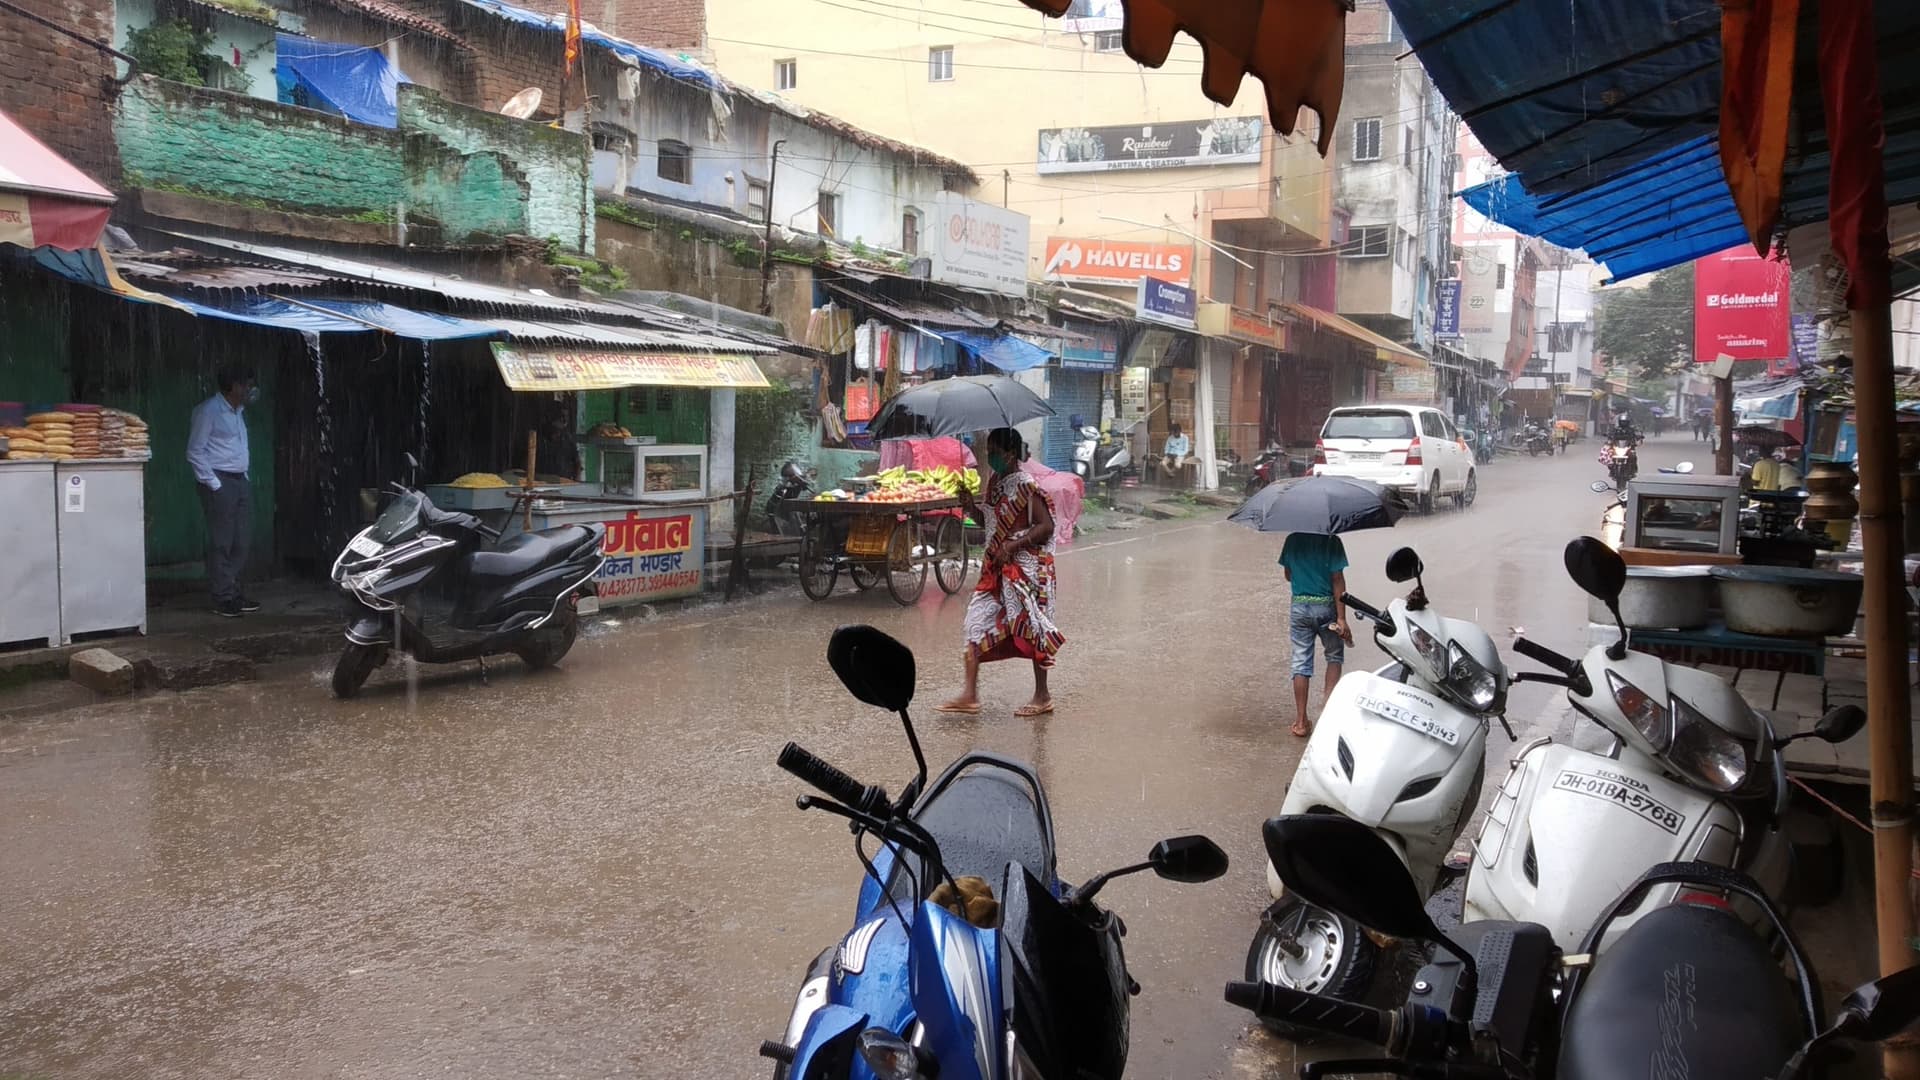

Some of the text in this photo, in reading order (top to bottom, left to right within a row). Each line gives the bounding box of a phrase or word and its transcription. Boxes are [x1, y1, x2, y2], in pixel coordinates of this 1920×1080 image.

[1122, 133, 1172, 153] Rainbow
[1144, 158, 1186, 168] CREATION
[1086, 249, 1182, 272] HAVELLS
[1157, 284, 1187, 304] Crompton
[1721, 291, 1778, 305] Goldmedal
[640, 552, 683, 573] भण्डार
[1397, 690, 1434, 708] HONDA
[1596, 769, 1650, 792] HONDA
[1560, 773, 1678, 829] JH-01BA-5768
